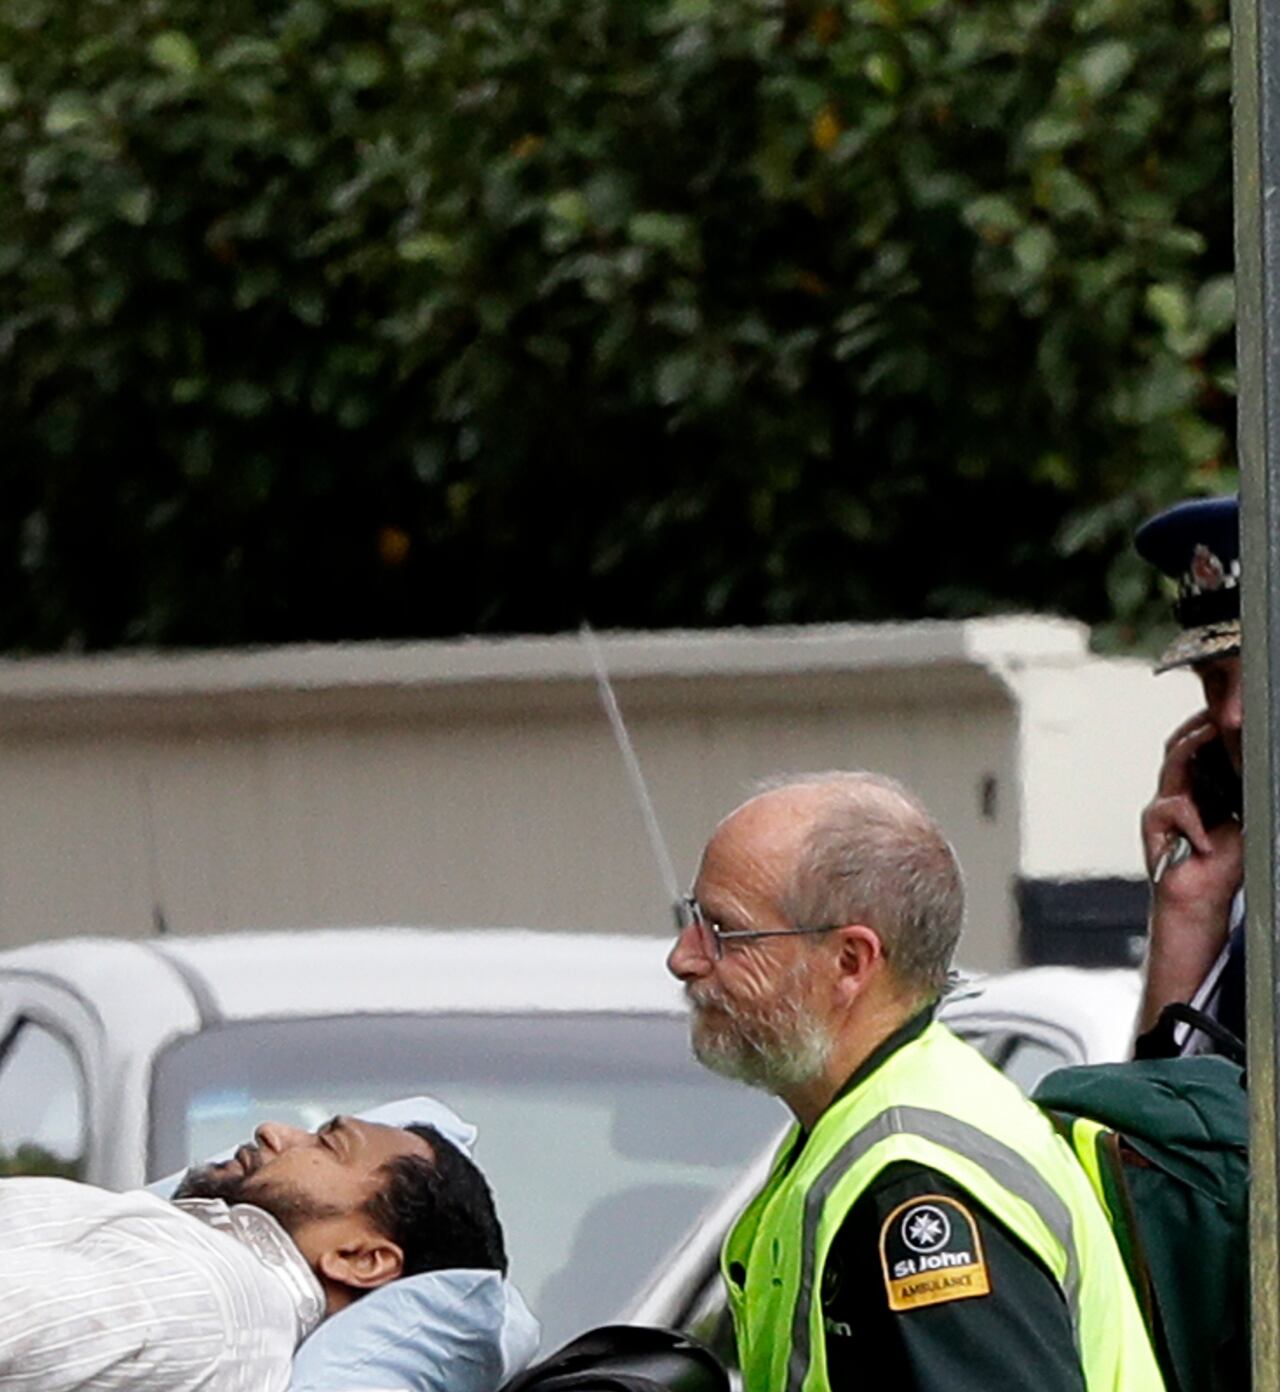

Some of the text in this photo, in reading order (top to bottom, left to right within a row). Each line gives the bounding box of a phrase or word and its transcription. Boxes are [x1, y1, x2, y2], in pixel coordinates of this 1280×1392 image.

[894, 1251, 971, 1278] St John
[901, 1274, 973, 1299] AMBULANCE
